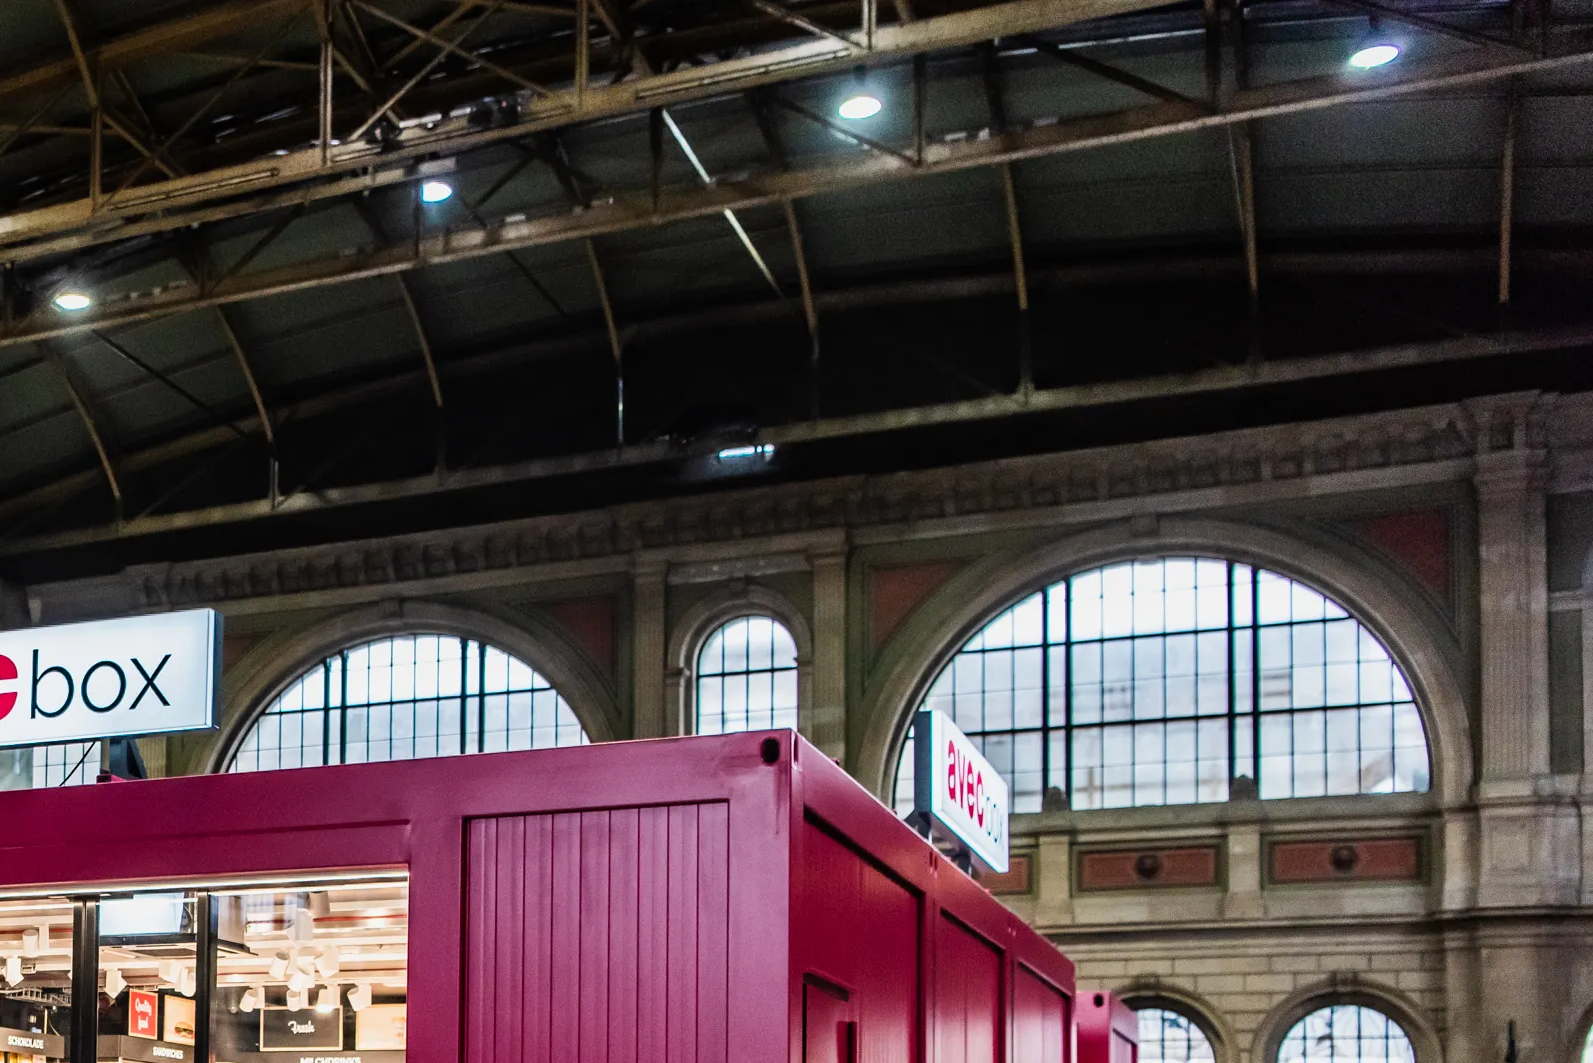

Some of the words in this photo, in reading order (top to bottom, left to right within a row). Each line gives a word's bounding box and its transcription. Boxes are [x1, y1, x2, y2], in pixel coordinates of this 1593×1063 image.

[30, 648, 172, 720] box
[948, 739, 984, 828] avec
[287, 1020, 315, 1035] Fresh
